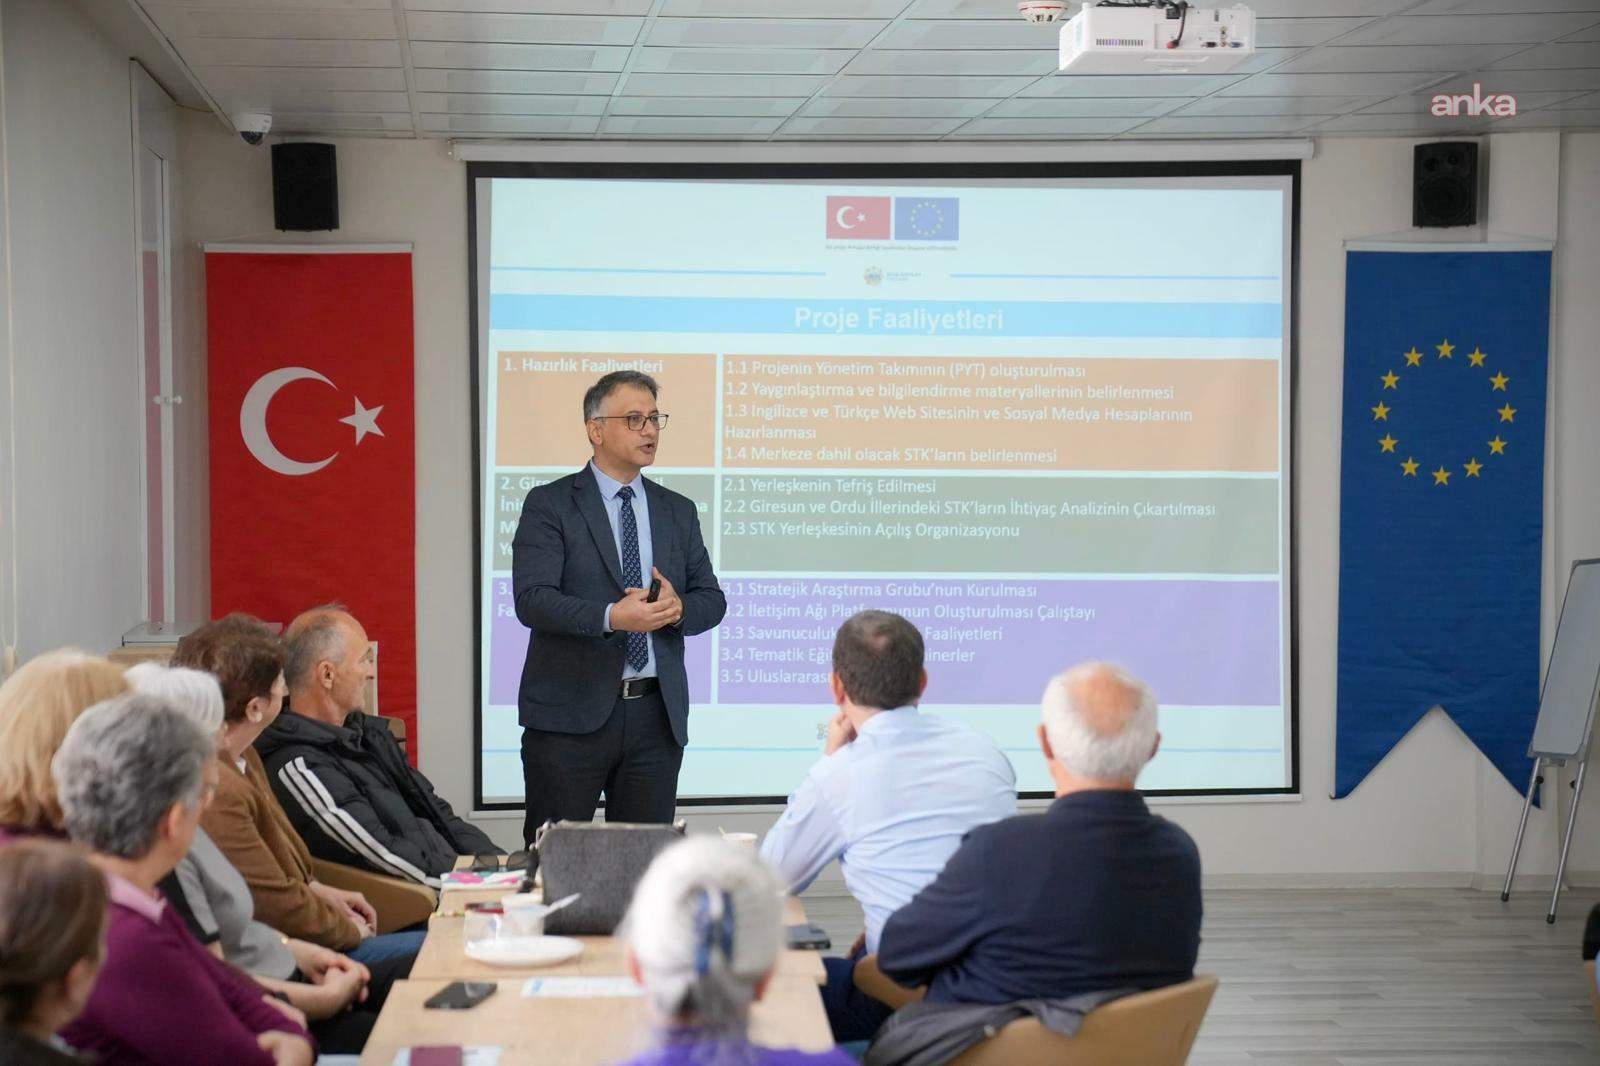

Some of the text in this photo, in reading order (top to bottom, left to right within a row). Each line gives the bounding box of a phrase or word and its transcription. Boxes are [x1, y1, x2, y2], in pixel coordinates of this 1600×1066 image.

[794, 307, 1004, 335] Proje Faaliyetleri
[504, 358, 517, 371] 1.
[522, 358, 577, 372] Hazırlık
[726, 360, 1086, 380] 1.1 Projenin Yönetim Takımının (PYT) oluşturulması
[726, 382, 1174, 401] 1.2 Yaygınlaştırma ve bilgilendirme materyallerinin belirlenmesi
[726, 404, 747, 417] 1.3
[812, 407, 829, 418] ve
[833, 404, 880, 421] Türkçe
[883, 405, 916, 419] Web
[920, 404, 979, 419] Sitesinin
[984, 408, 999, 419] ve
[1004, 406, 1047, 423] Sosyal
[1052, 407, 1100, 423] Medya
[1104, 407, 1192, 423] Hesaplarının
[725, 425, 816, 439] Hazırlanması
[725, 446, 746, 460] 1.4
[751, 446, 812, 461] Merkeze
[817, 446, 851, 461] dahil
[856, 447, 900, 461] olacak
[970, 448, 1057, 462] belirlenmesi
[501, 476, 515, 490] 2.
[724, 477, 936, 495] 2.1 Yerleşkenin Tefriş Edilmesi
[724, 499, 745, 513] 2.2
[750, 499, 805, 513] Giresun
[809, 503, 826, 514] ve
[830, 499, 866, 514] Ordu
[1060, 501, 1129, 516] Analizinin
[1133, 501, 1216, 519] Çıkartılması
[723, 521, 1020, 540] 2.3 STK Yerleşkesinin Açılış Organizasyonu
[748, 582, 808, 599] Stratejik
[811, 583, 882, 600] Araştırma
[967, 583, 1037, 598] Kurulması
[804, 603, 827, 620] Ağı
[934, 604, 1033, 621] Oluşturulması
[1037, 604, 1096, 622] Çalıştayı
[721, 626, 744, 640] 3.3
[925, 626, 1002, 644] Faaliyetleri
[721, 647, 744, 661] 3.4
[748, 647, 804, 662] Tematik
[721, 669, 743, 683] 3.5
